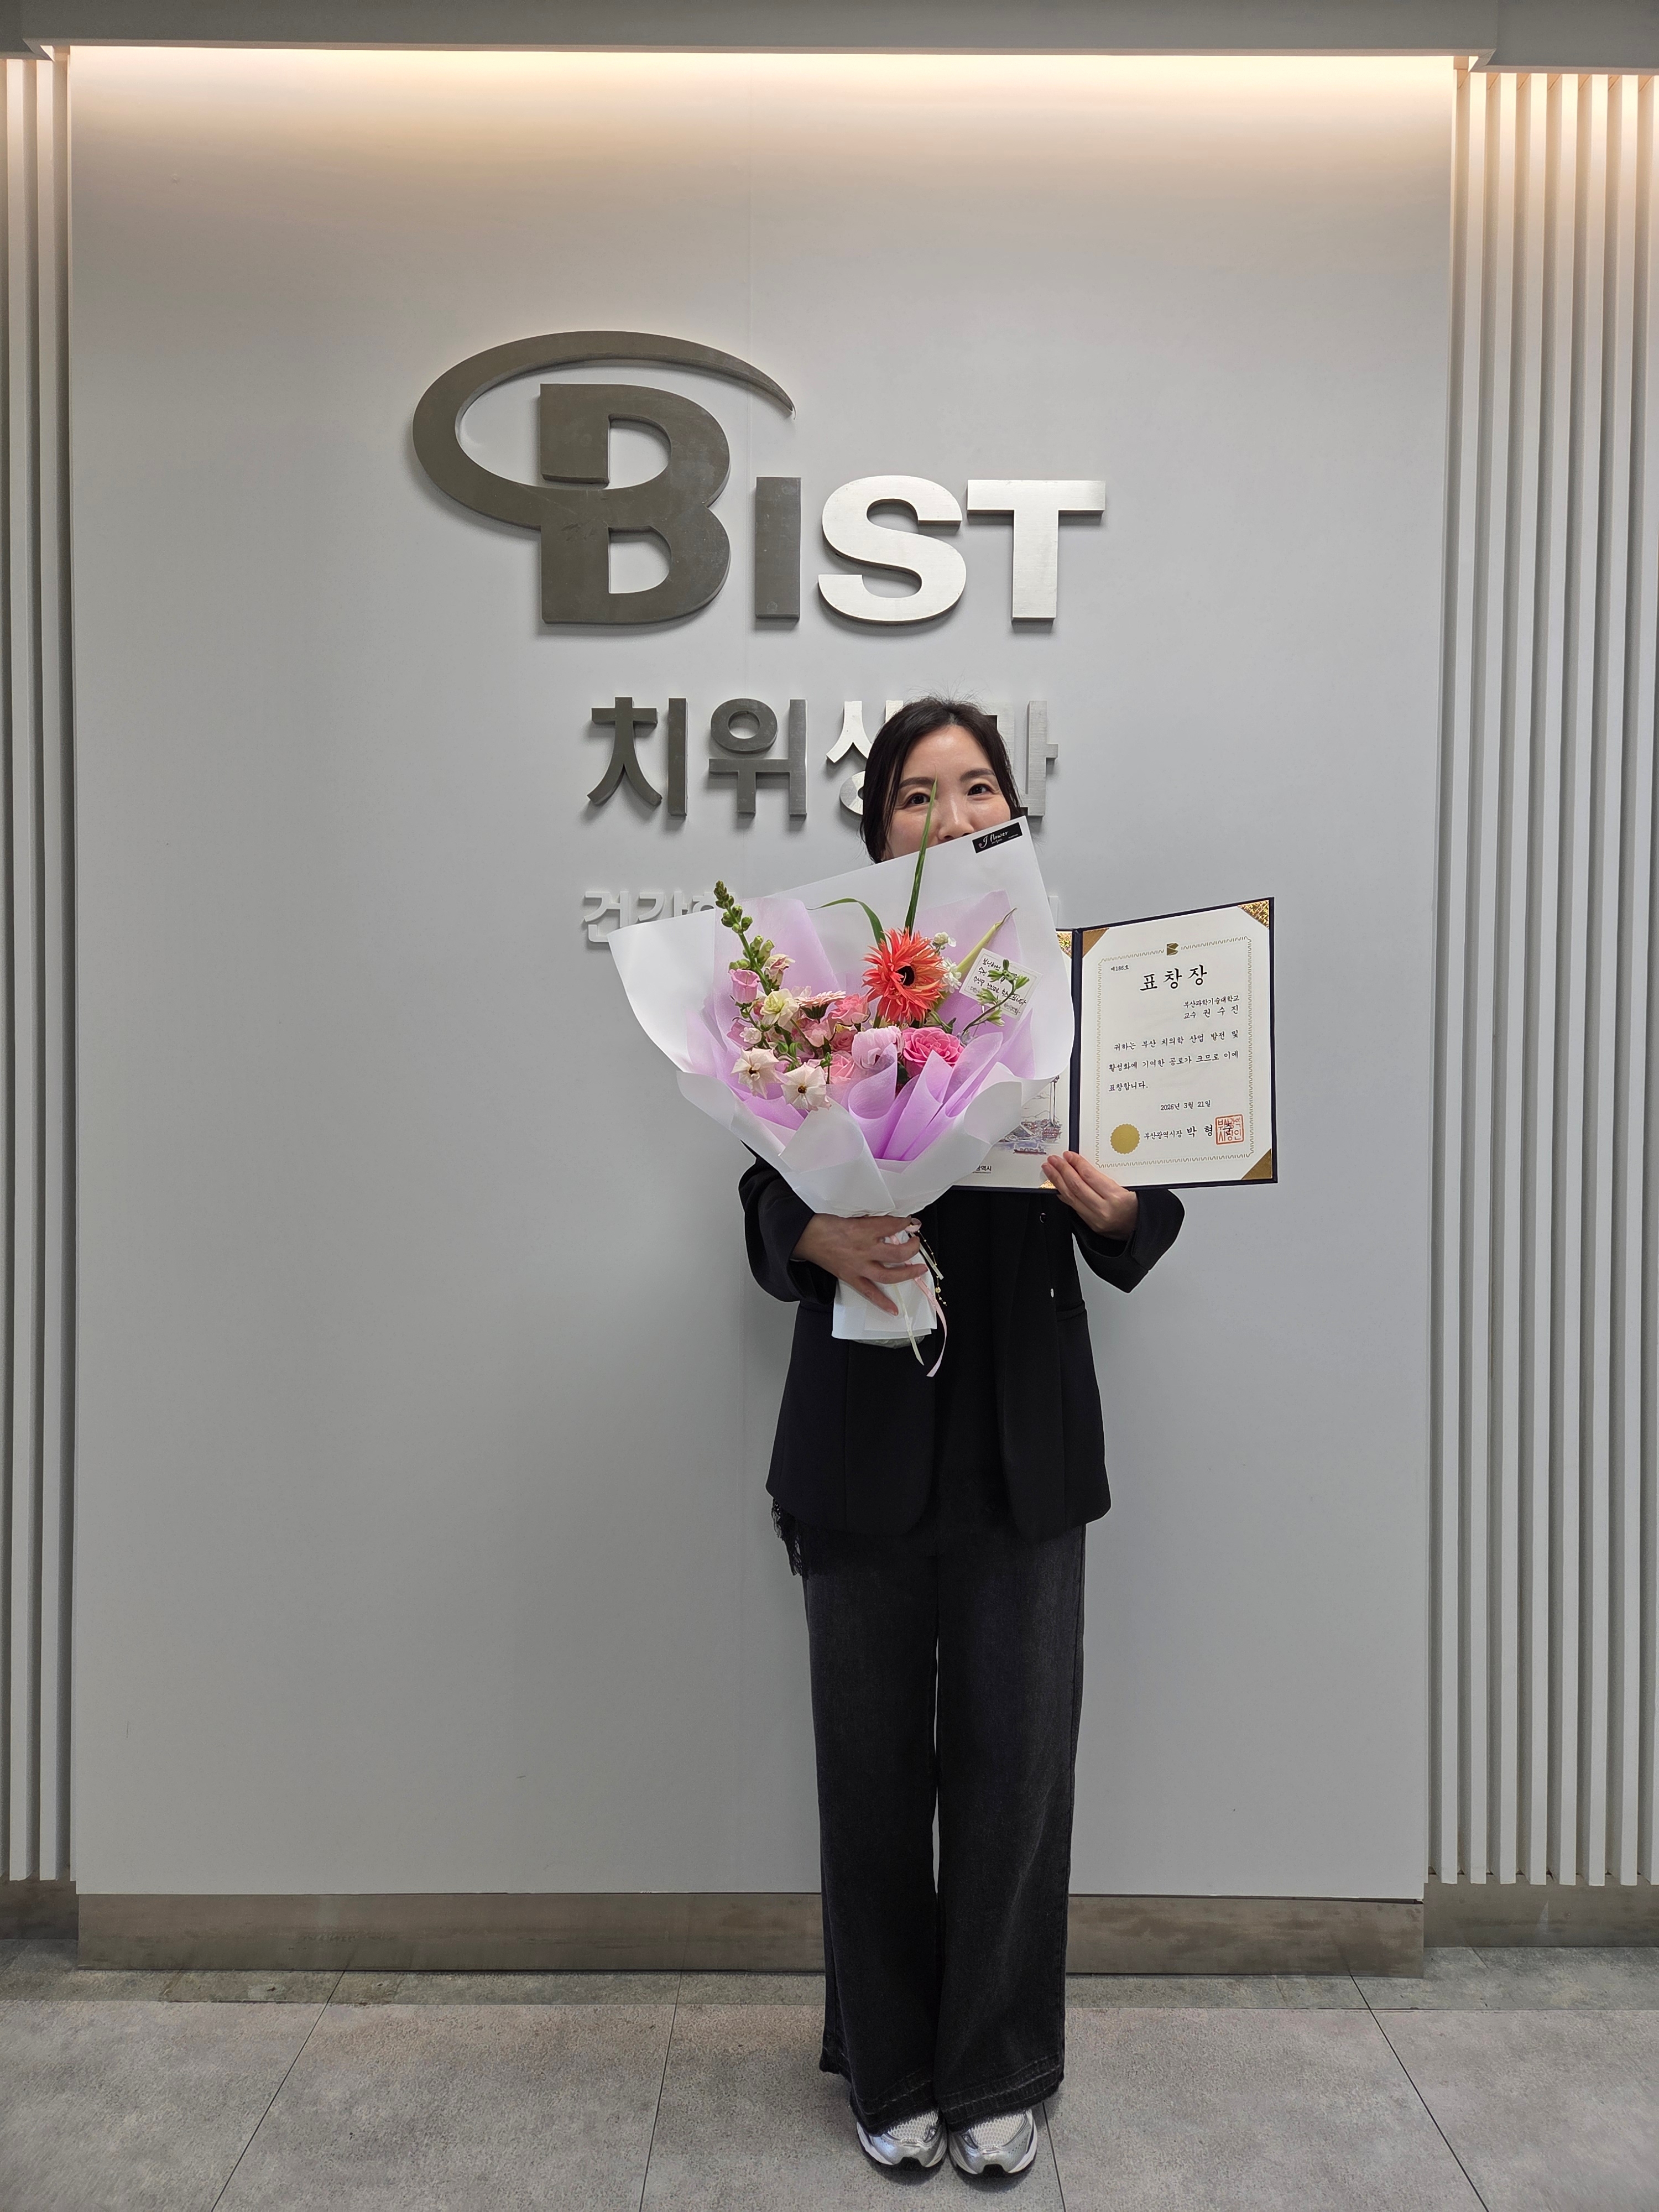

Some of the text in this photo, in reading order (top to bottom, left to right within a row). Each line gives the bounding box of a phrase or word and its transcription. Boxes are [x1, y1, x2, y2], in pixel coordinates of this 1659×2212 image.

[540, 384, 1105, 624] BIST
[990, 831, 1009, 842] flower
[1140, 964, 1207, 991] 표창장
[1183, 995, 1240, 1008] 부산과학기술대학교
[1183, 1011, 1196, 1020] 교수
[1114, 1030, 1239, 1051] 귀하는 부산 치의학 산업 발전 및
[1109, 1051, 1239, 1072] 활성화에 기여한 공로가 크므로 이에
[1108, 1081, 1149, 1092] 표창합니다.
[1183, 1101, 1193, 1109] 3월
[1197, 1100, 1211, 1108] 21일
[1143, 1127, 1183, 1140] 부산광역시장
